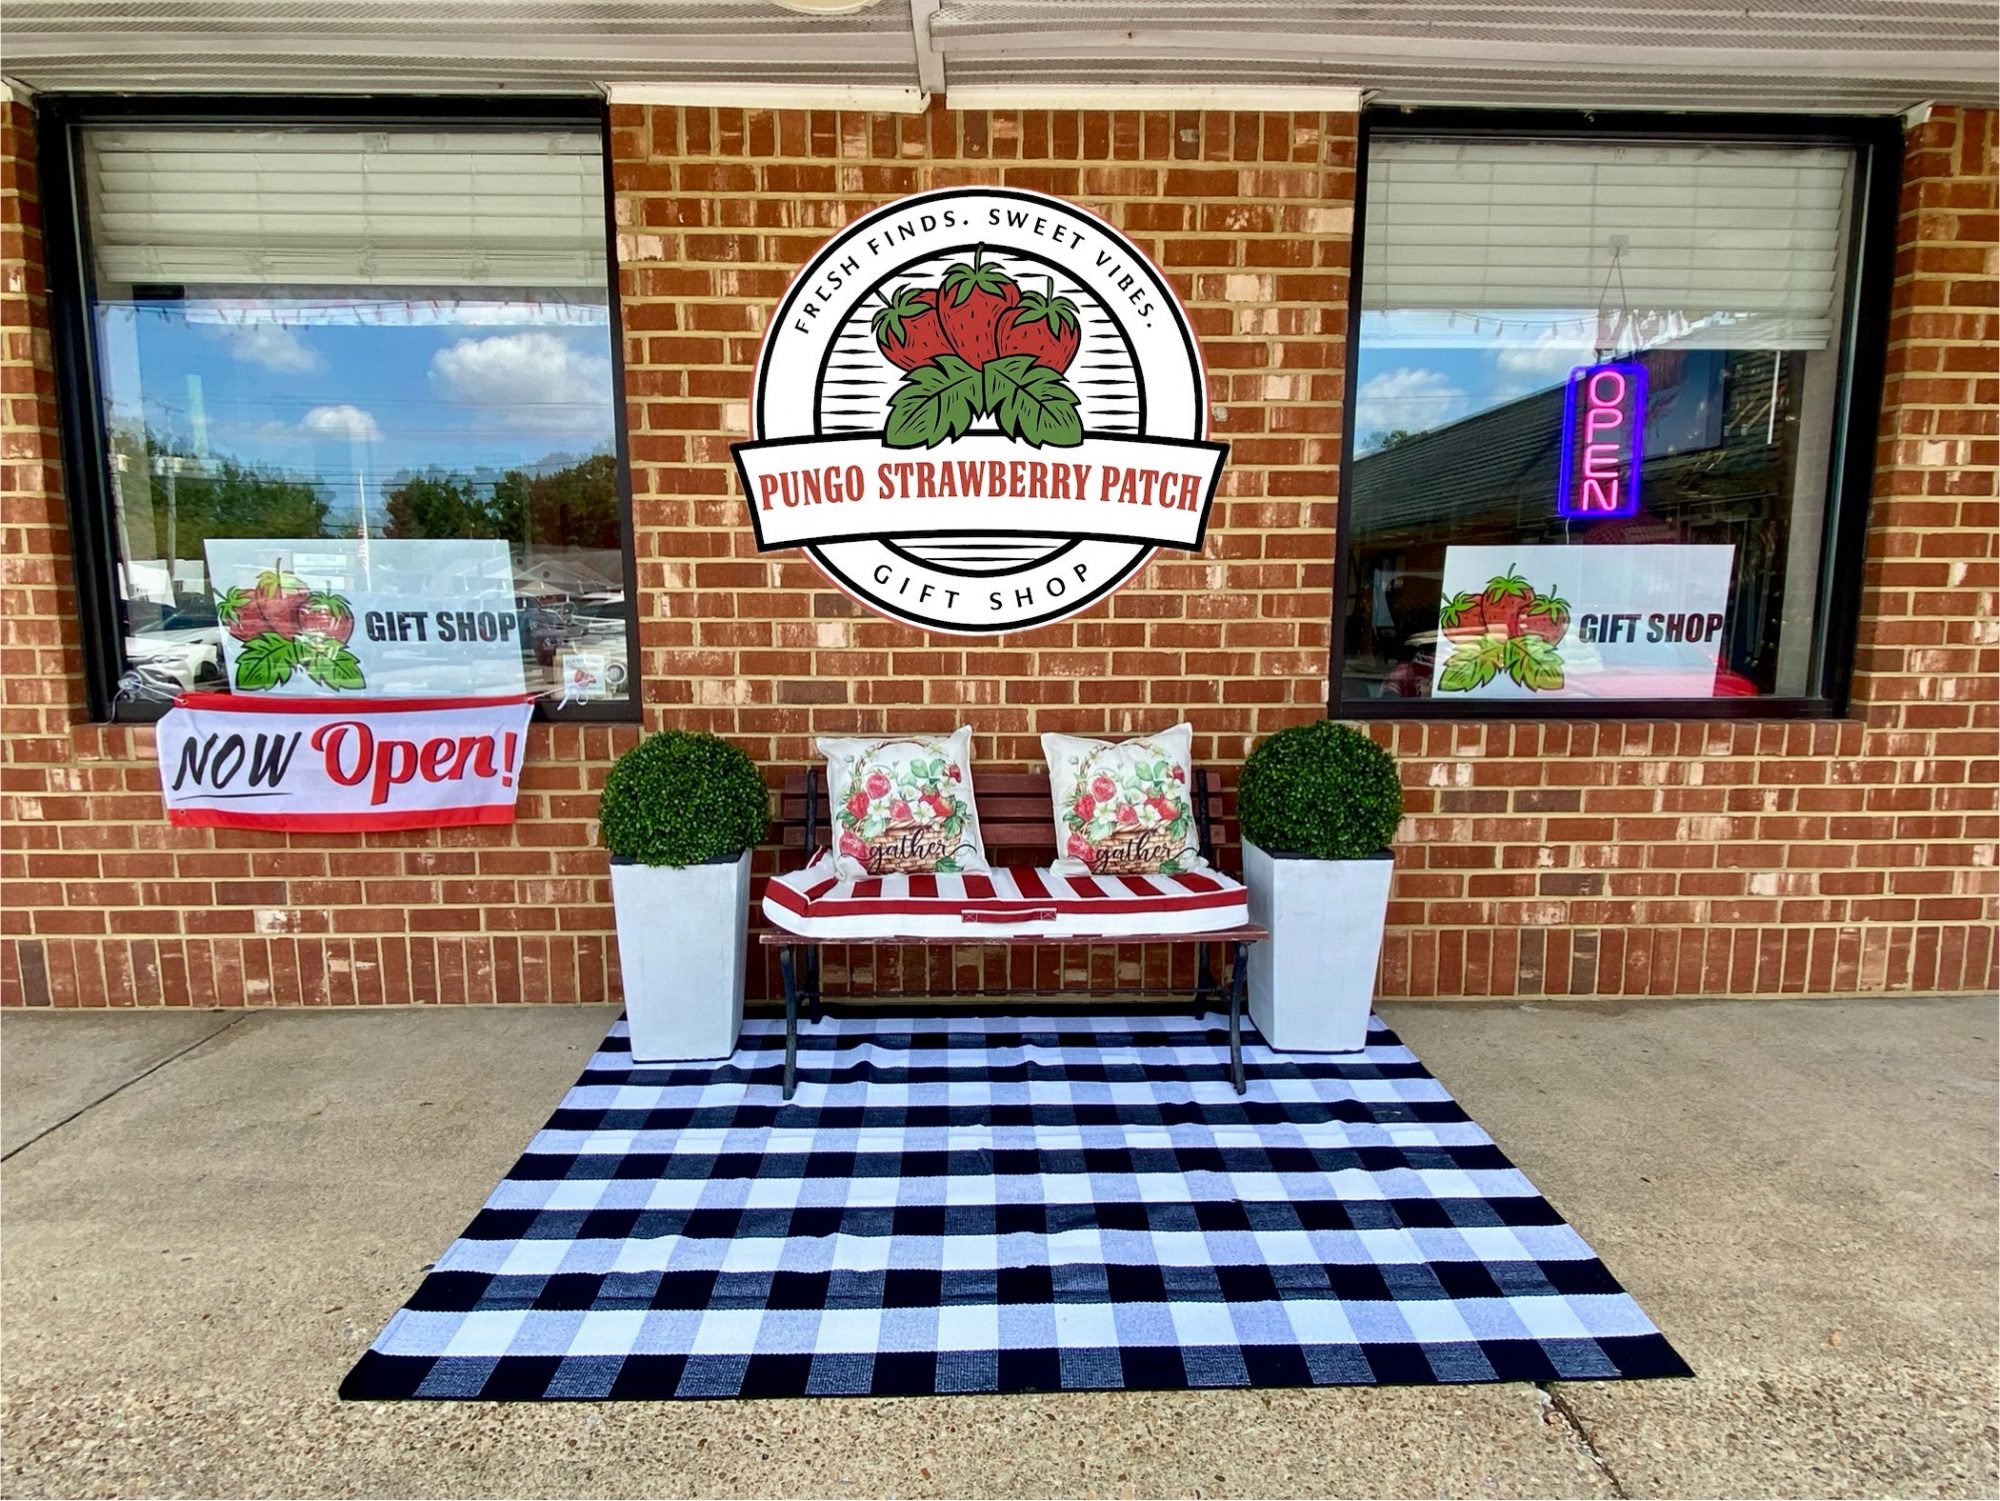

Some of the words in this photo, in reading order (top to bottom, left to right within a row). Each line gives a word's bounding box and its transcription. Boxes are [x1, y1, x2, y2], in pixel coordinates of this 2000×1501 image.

[794, 256, 860, 334] FRESH
[868, 210, 970, 254] FINDS.
[989, 208, 1085, 250] SWEET
[1095, 250, 1154, 328] VIBES.
[1581, 371, 1626, 511] OPEN
[758, 465, 865, 511] PUNGO
[879, 460, 1092, 501] STRAWBERRY
[1100, 465, 1203, 512] PATCH
[873, 564, 960, 609] GIFT
[990, 563, 1088, 611] SHOP
[365, 611, 428, 642] GIFT
[437, 611, 516, 642] SHOP
[1579, 614, 1642, 643] GIFT
[1646, 613, 1724, 643] SHOP
[172, 731, 301, 791] NOW
[310, 721, 517, 805] Open!
[867, 827, 977, 875] gather
[1092, 829, 1198, 875] gather
